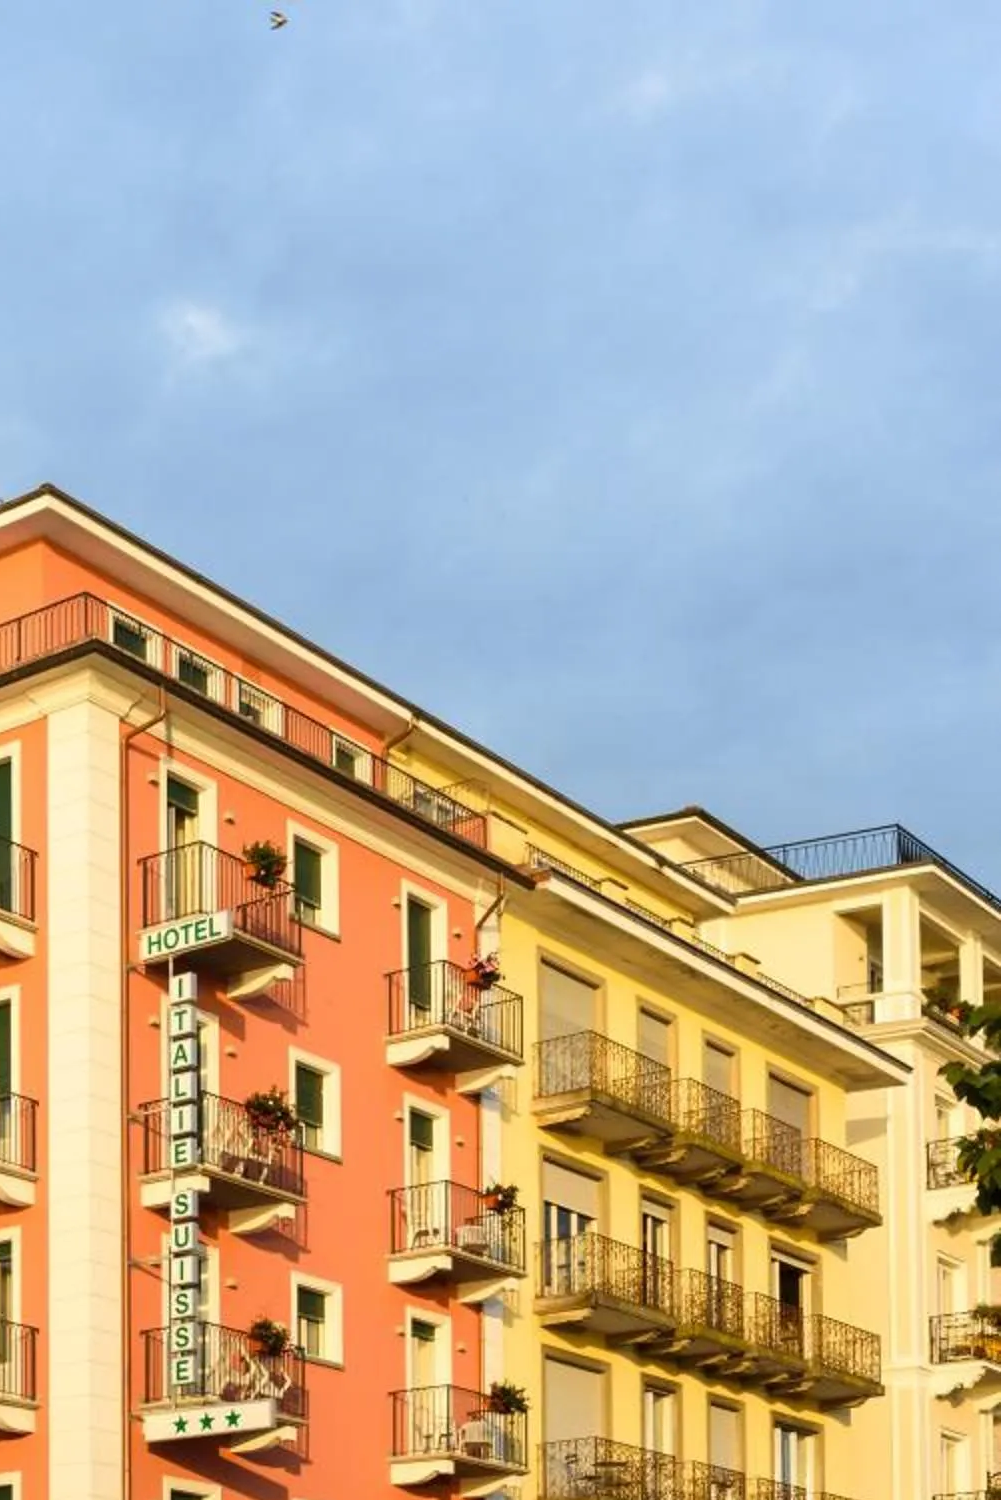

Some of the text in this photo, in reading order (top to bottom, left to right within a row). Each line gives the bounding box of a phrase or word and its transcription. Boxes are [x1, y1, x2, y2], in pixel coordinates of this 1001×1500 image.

[147, 917, 222, 955] HOTEL
[172, 977, 190, 1381] ITALIE SUISSE
